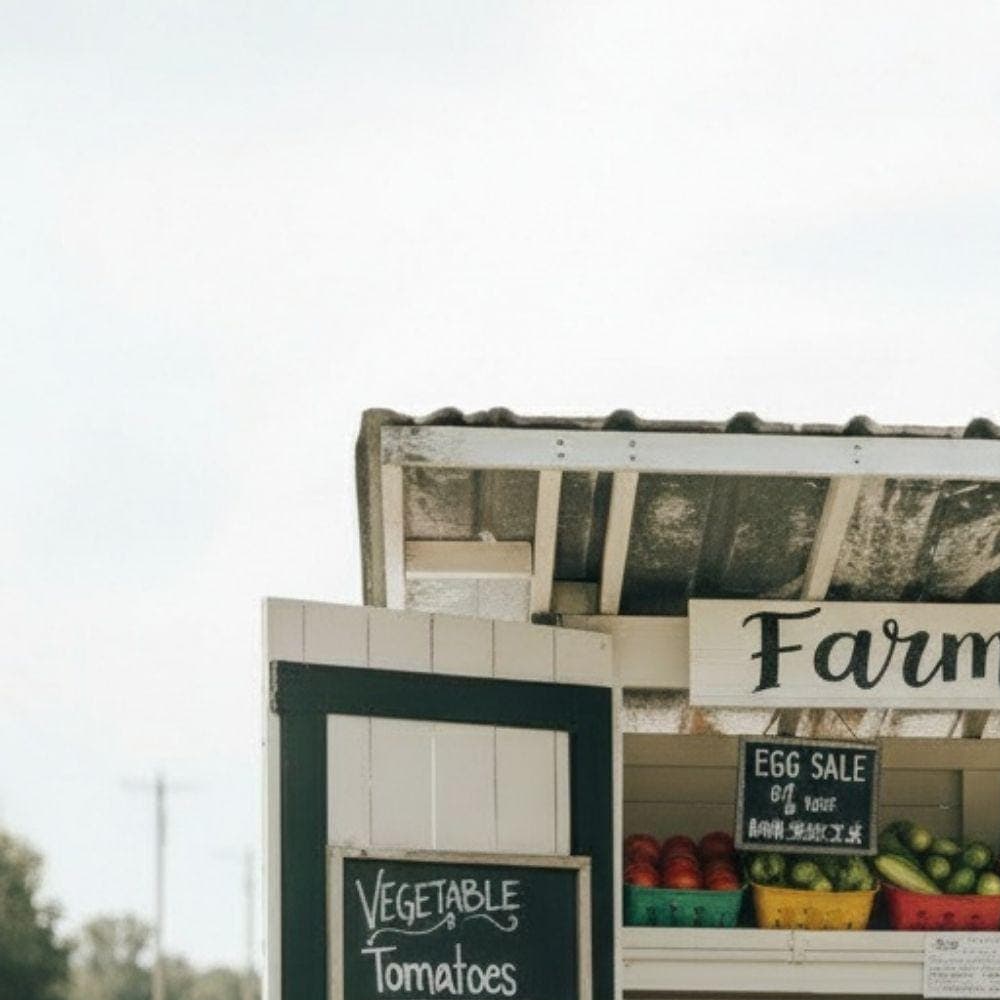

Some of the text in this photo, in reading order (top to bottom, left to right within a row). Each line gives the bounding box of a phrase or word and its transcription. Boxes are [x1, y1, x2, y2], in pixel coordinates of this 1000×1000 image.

[755, 748, 867, 783] EGG SALE
[355, 869, 520, 929] VEGETABLE
[361, 943, 517, 996] Tomatoes
